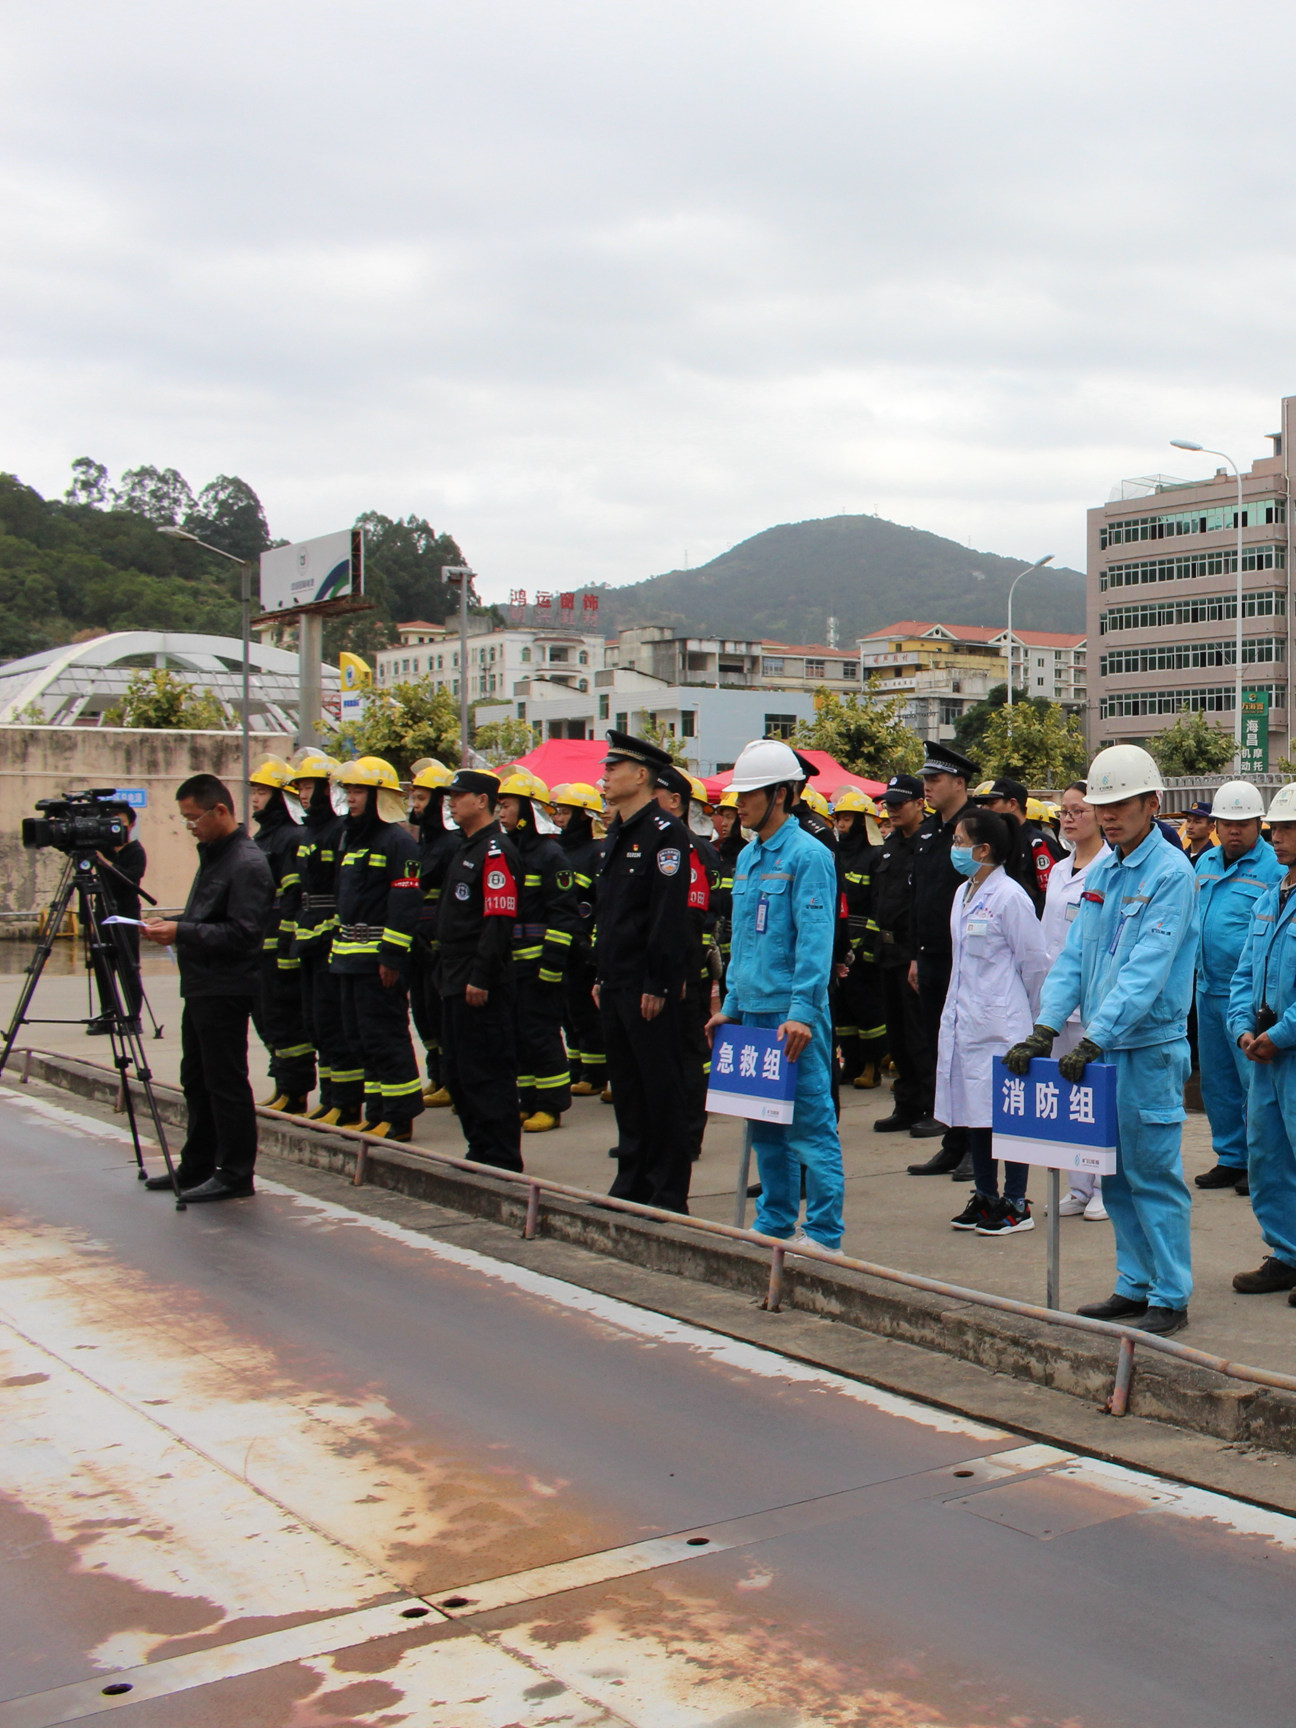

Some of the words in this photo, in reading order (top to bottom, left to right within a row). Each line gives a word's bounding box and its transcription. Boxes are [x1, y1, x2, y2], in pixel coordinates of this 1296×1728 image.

[1246, 720, 1259, 746] 海昌
[1241, 748, 1251, 775] 机动
[716, 1041, 781, 1081] 急救组
[1002, 1078, 1095, 1123] 消防组
